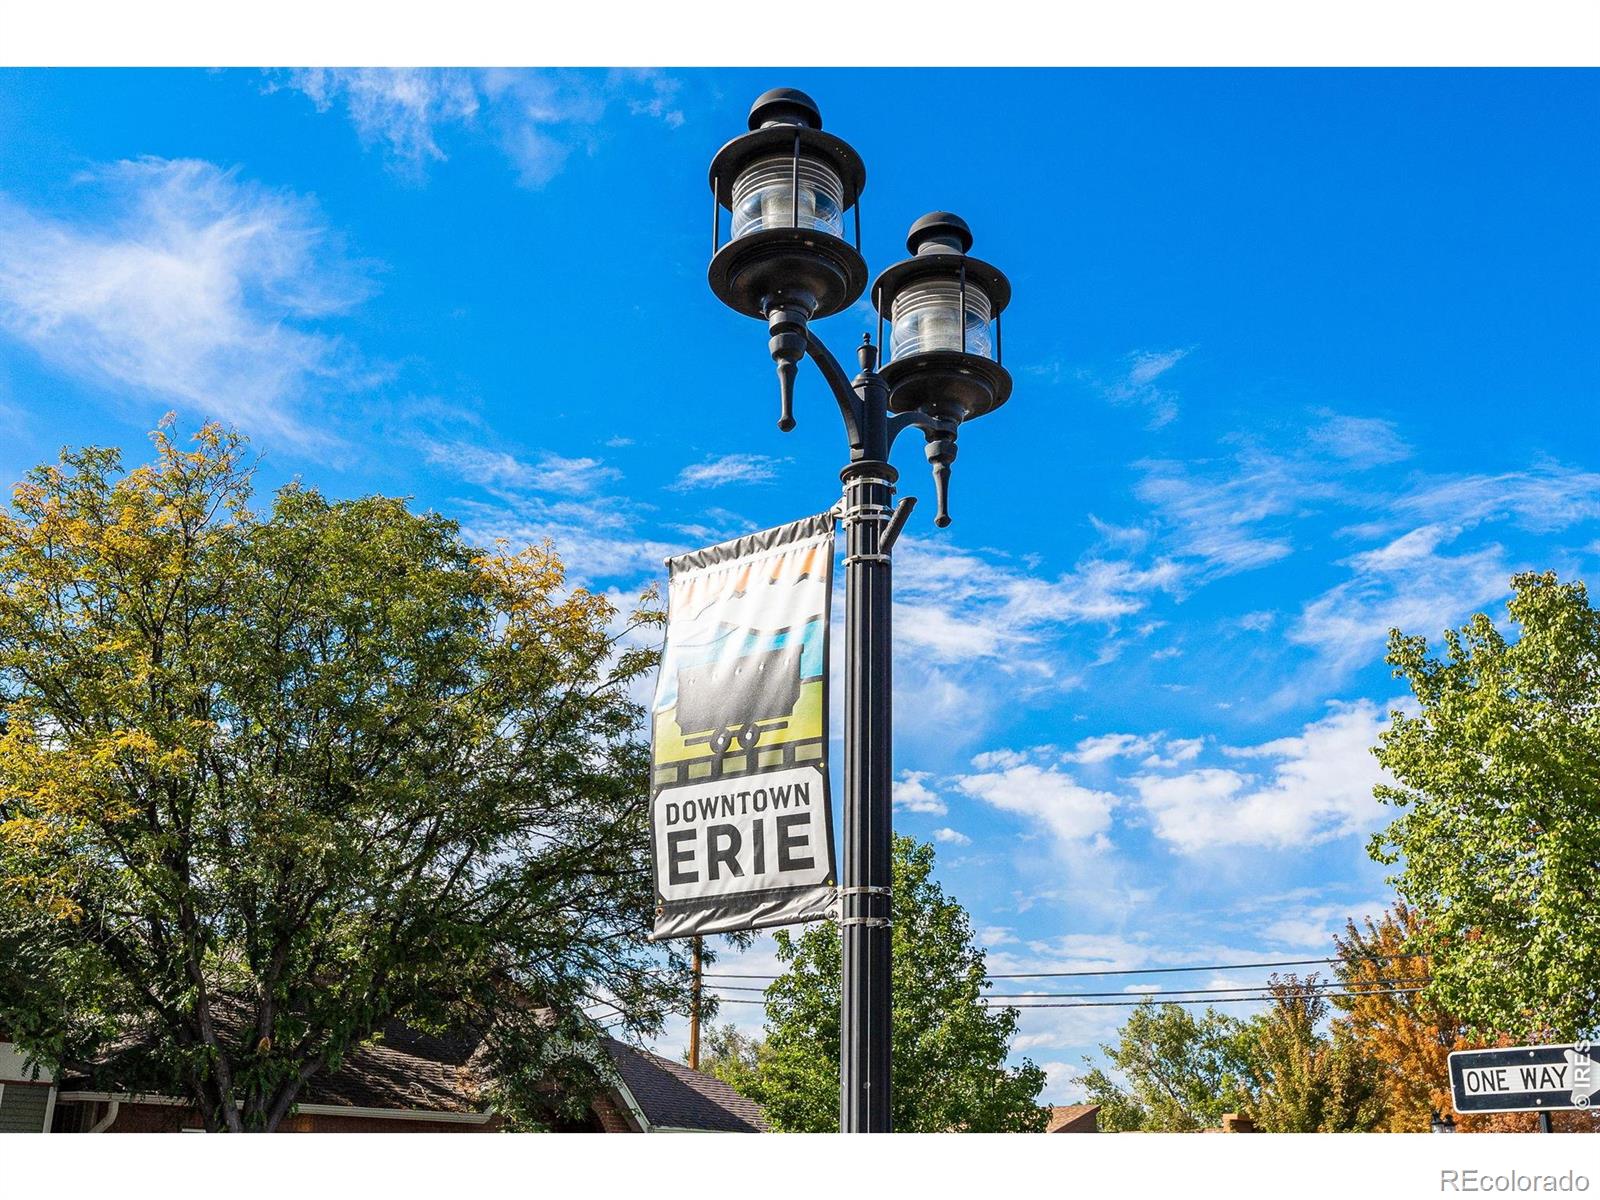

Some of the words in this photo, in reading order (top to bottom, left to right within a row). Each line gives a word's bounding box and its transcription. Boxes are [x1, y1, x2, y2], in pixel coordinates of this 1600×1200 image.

[666, 782, 810, 825] DOWNTOWN
[667, 812, 815, 886] ERIE
[1467, 1069, 1509, 1092] ONE
[1520, 1066, 1567, 1090] WAY
